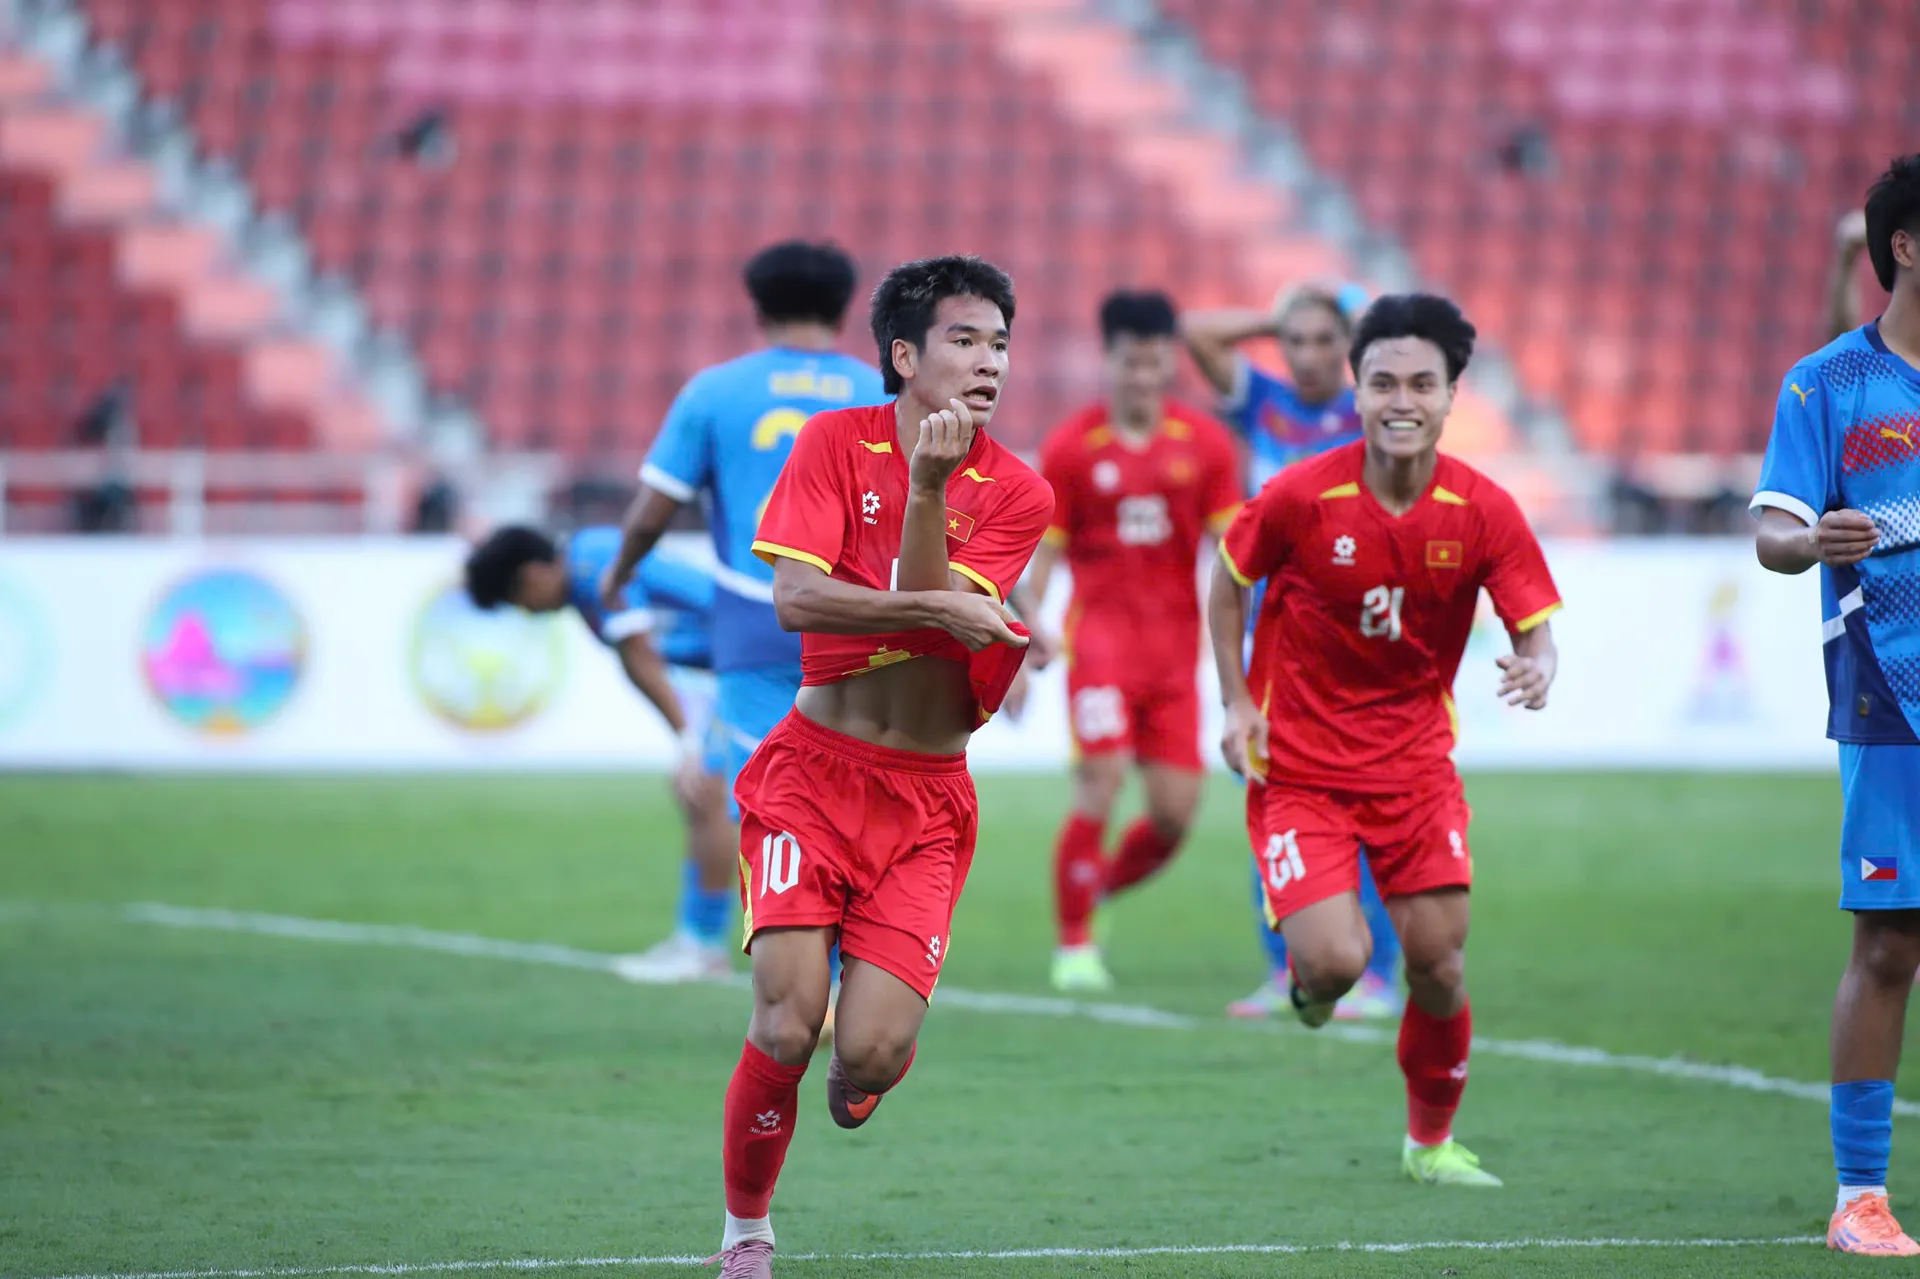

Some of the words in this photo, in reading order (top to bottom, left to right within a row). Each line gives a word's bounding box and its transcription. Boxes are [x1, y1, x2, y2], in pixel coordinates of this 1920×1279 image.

[1360, 585, 1404, 641] 21
[760, 829, 802, 900] 10
[1263, 828, 1306, 891] 21
